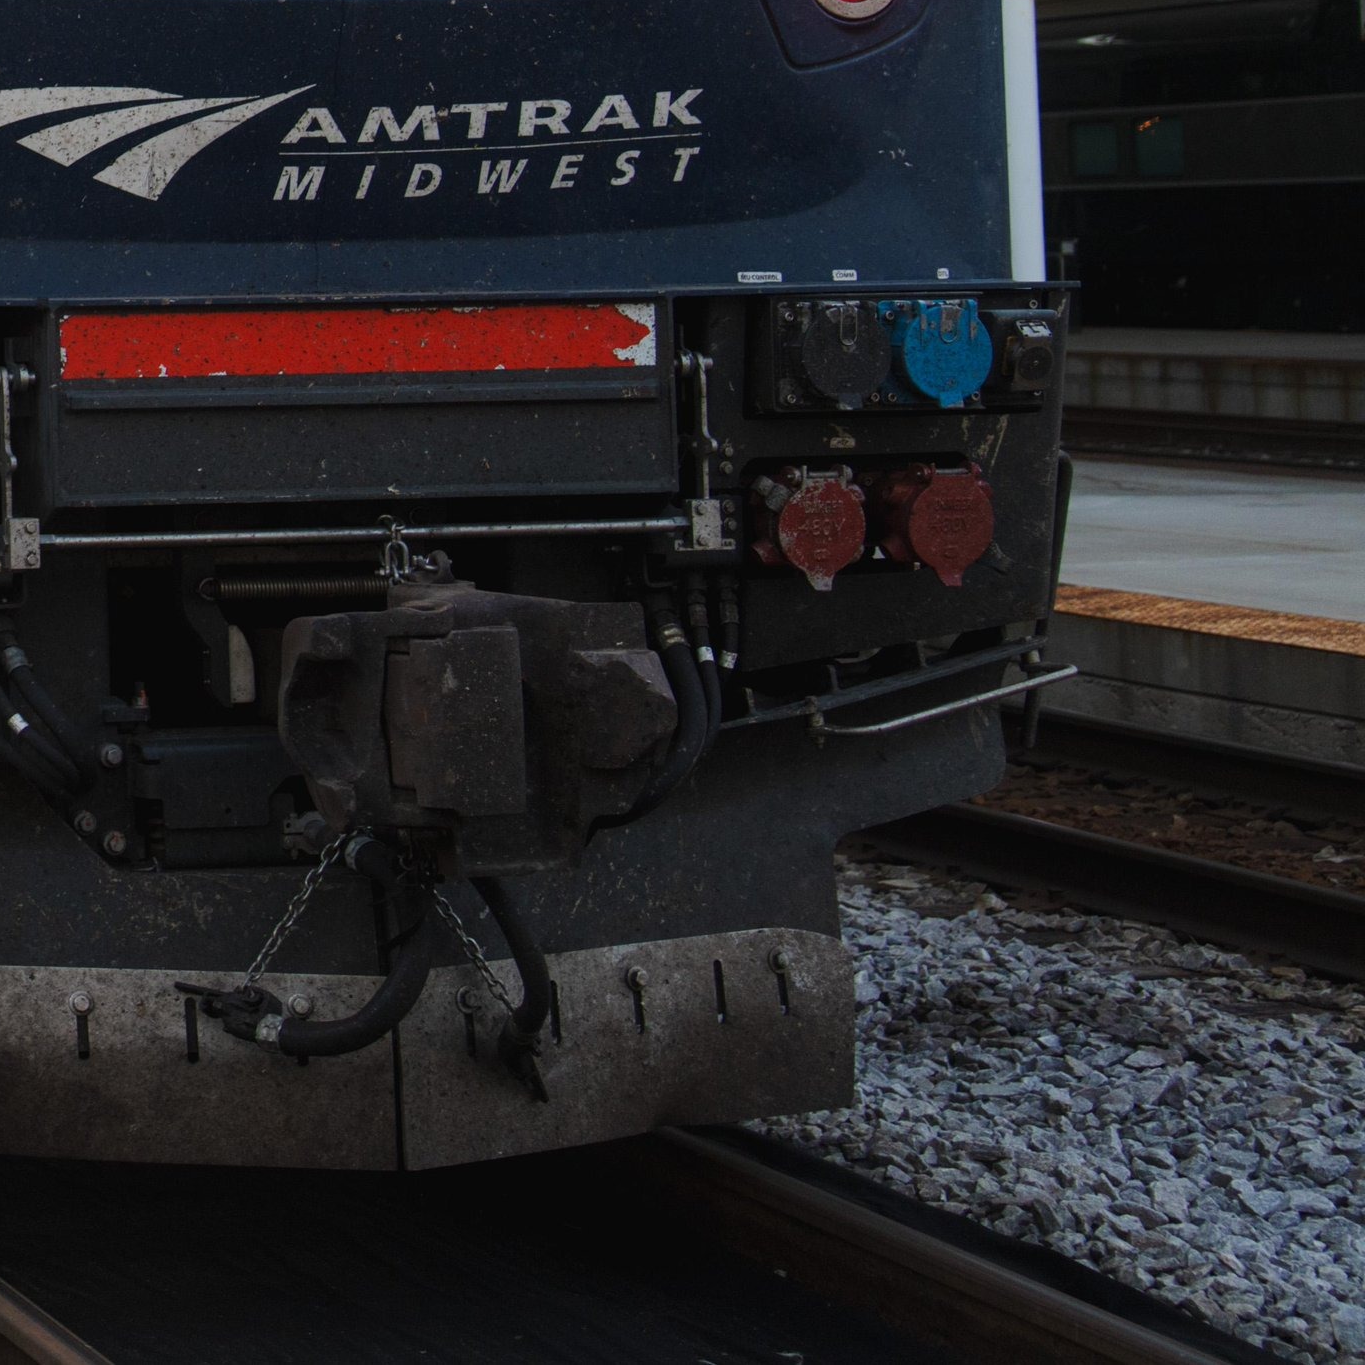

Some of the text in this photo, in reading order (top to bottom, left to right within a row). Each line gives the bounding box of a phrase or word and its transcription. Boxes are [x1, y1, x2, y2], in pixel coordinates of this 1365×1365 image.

[279, 88, 705, 145] AMTRAK
[272, 146, 701, 202] MIDWEST
[752, 273, 779, 281] CONTROL
